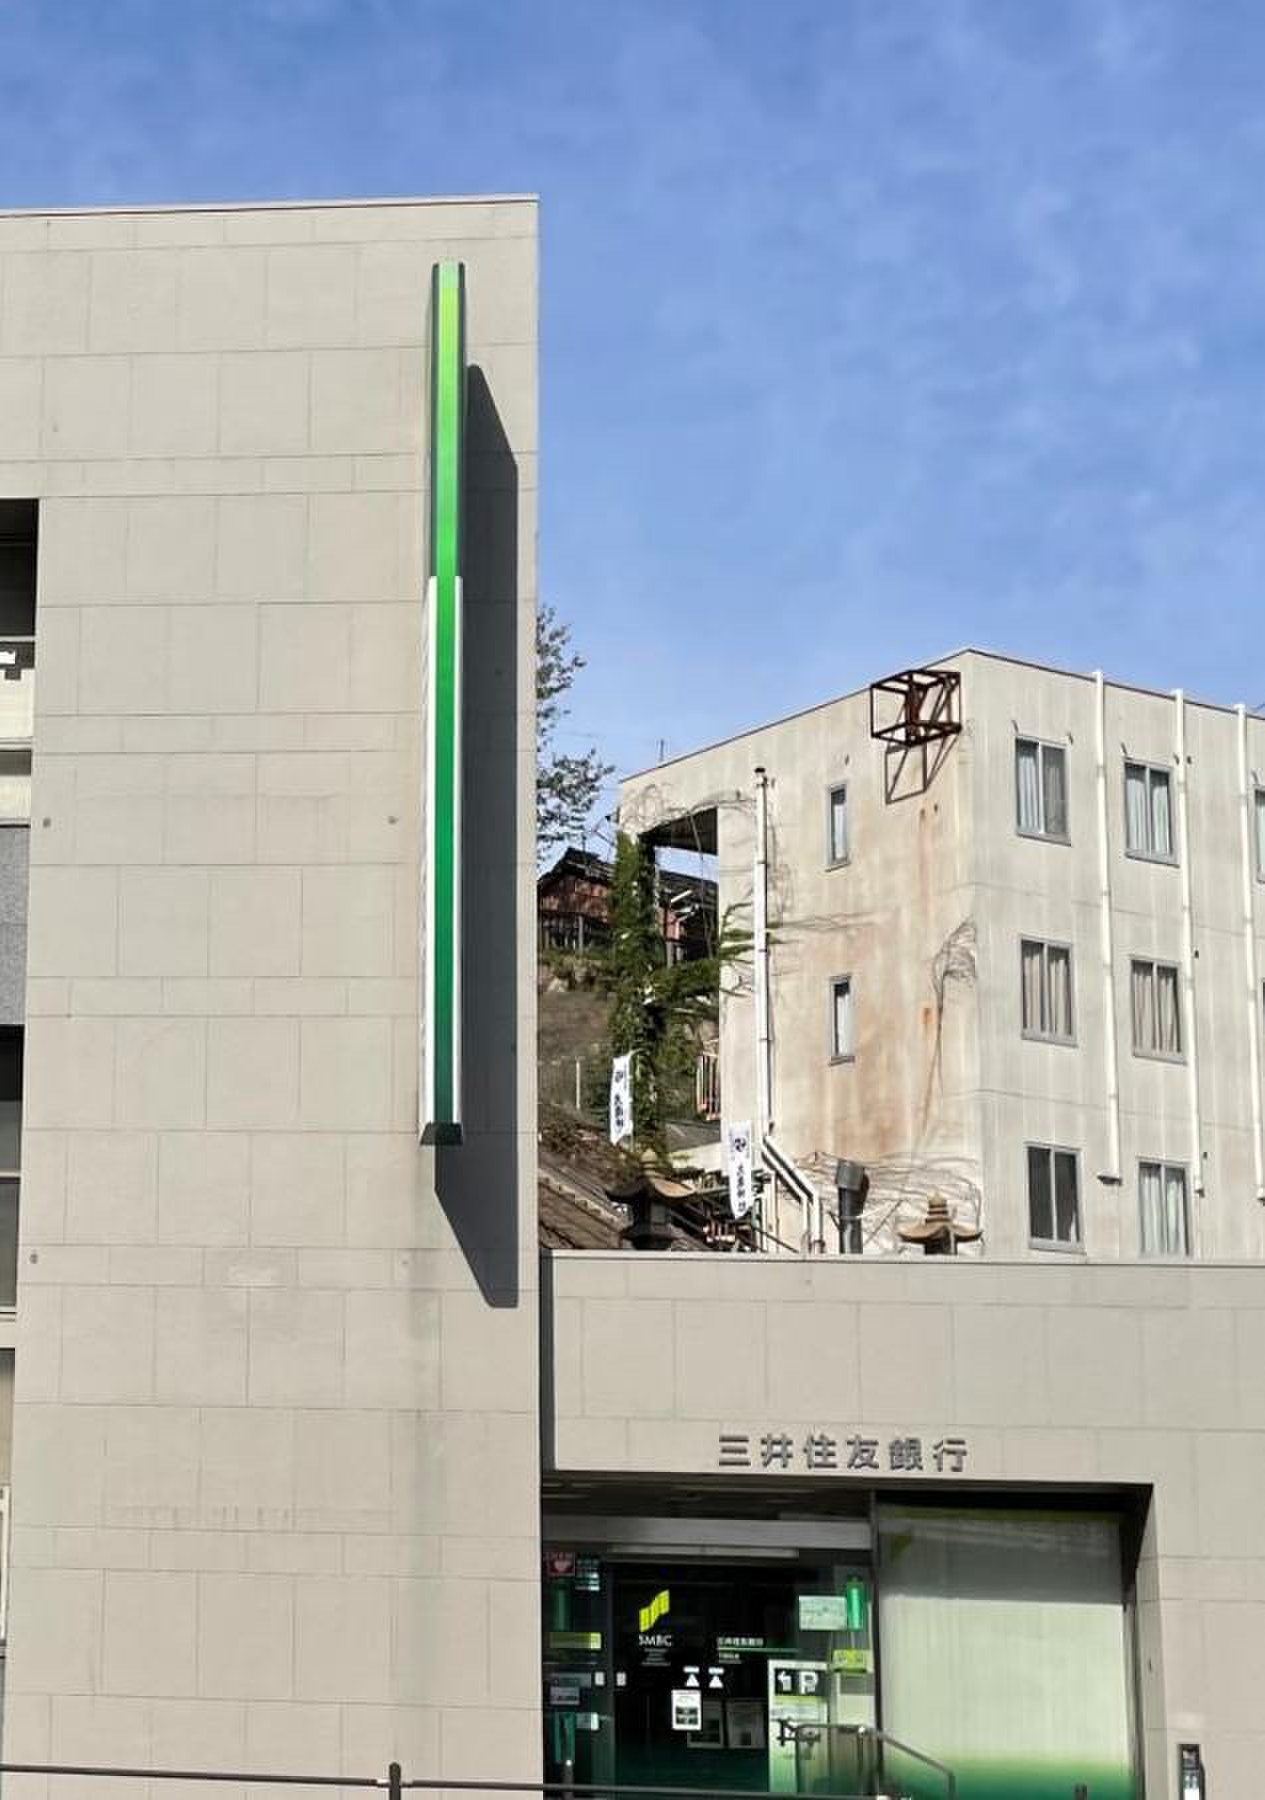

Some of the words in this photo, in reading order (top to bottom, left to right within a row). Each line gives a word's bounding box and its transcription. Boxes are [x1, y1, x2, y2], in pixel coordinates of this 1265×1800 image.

[718, 1433, 968, 1472] 三井住友銀行
[638, 1633, 672, 1647] SMBC
